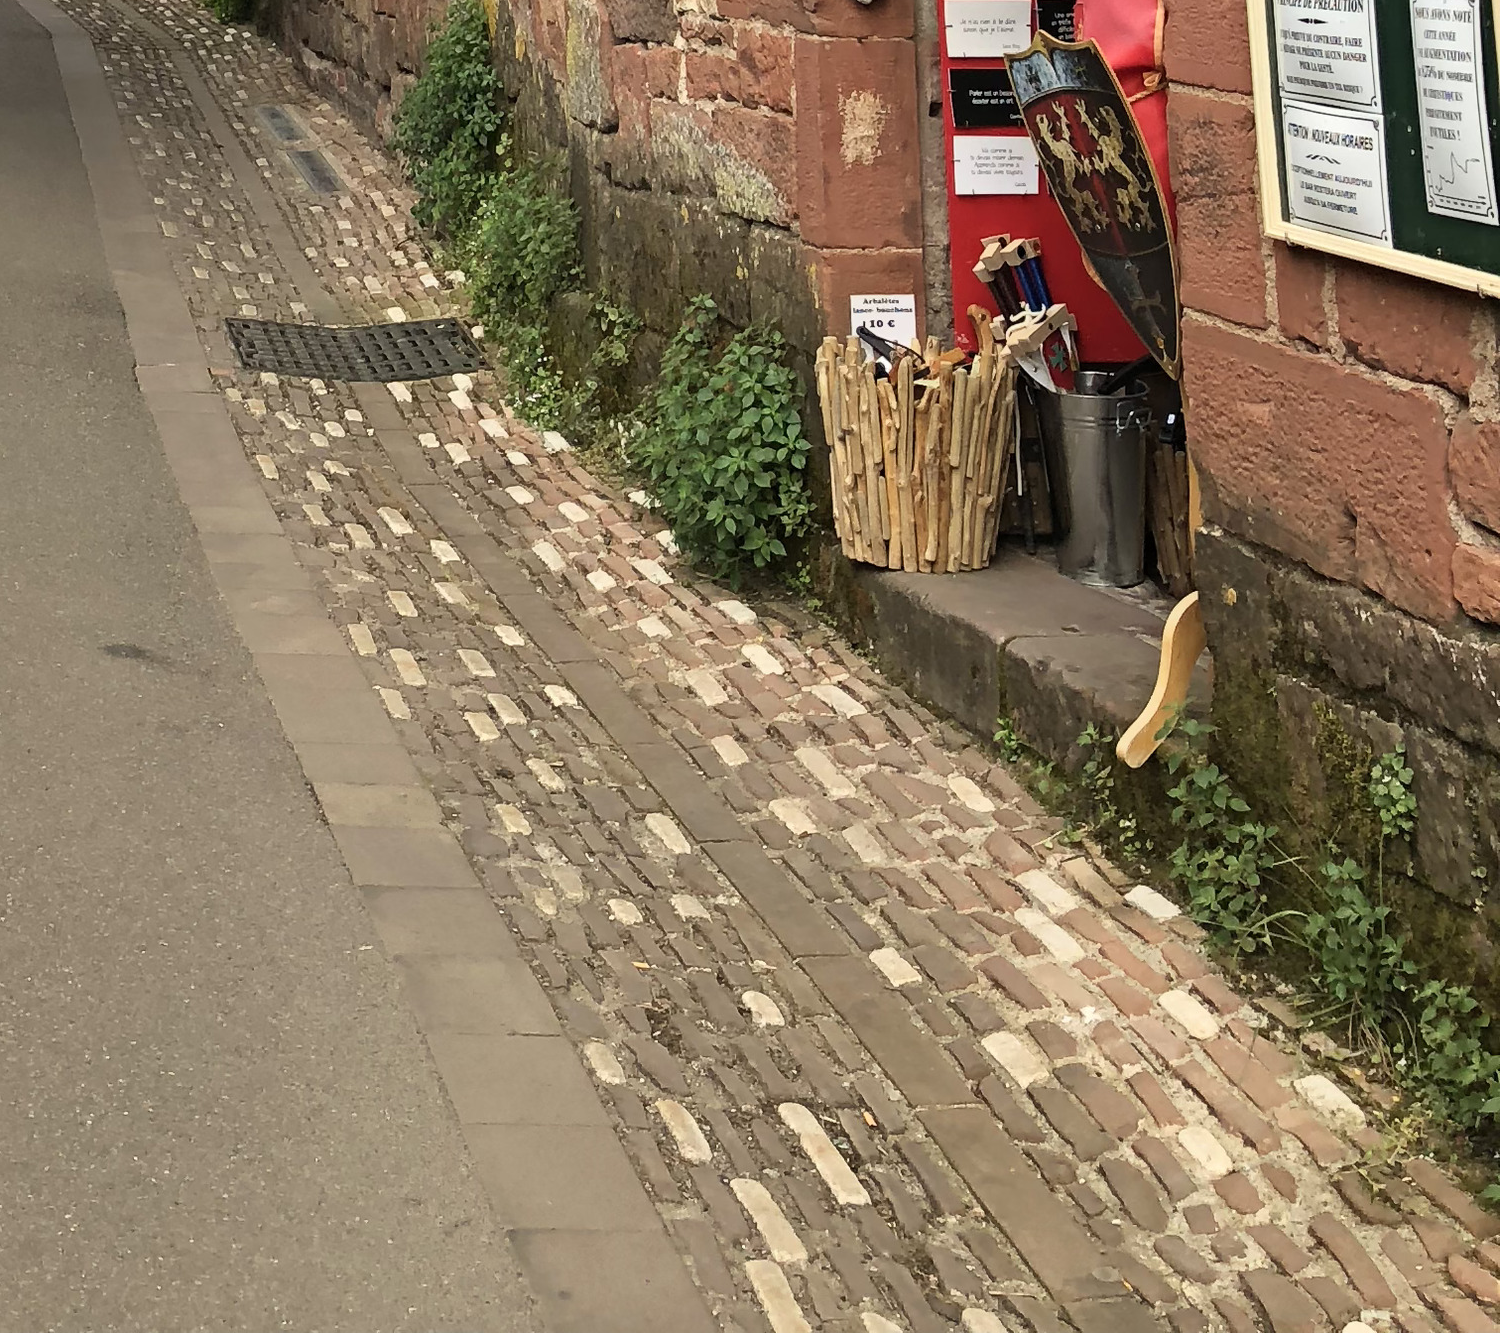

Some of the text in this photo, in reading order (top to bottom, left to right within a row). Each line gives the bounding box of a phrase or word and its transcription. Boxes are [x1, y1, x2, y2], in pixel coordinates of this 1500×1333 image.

[1415, 7, 1472, 23] NOUS AVONS NOTÉ
[1345, 37, 1362, 47] FAIRE
[1343, 52, 1367, 62] DANGER
[1312, 129, 1340, 146] NOUVEAUX
[1341, 134, 1373, 151] HORAIRES
[870, 319, 895, 328] 10 €
